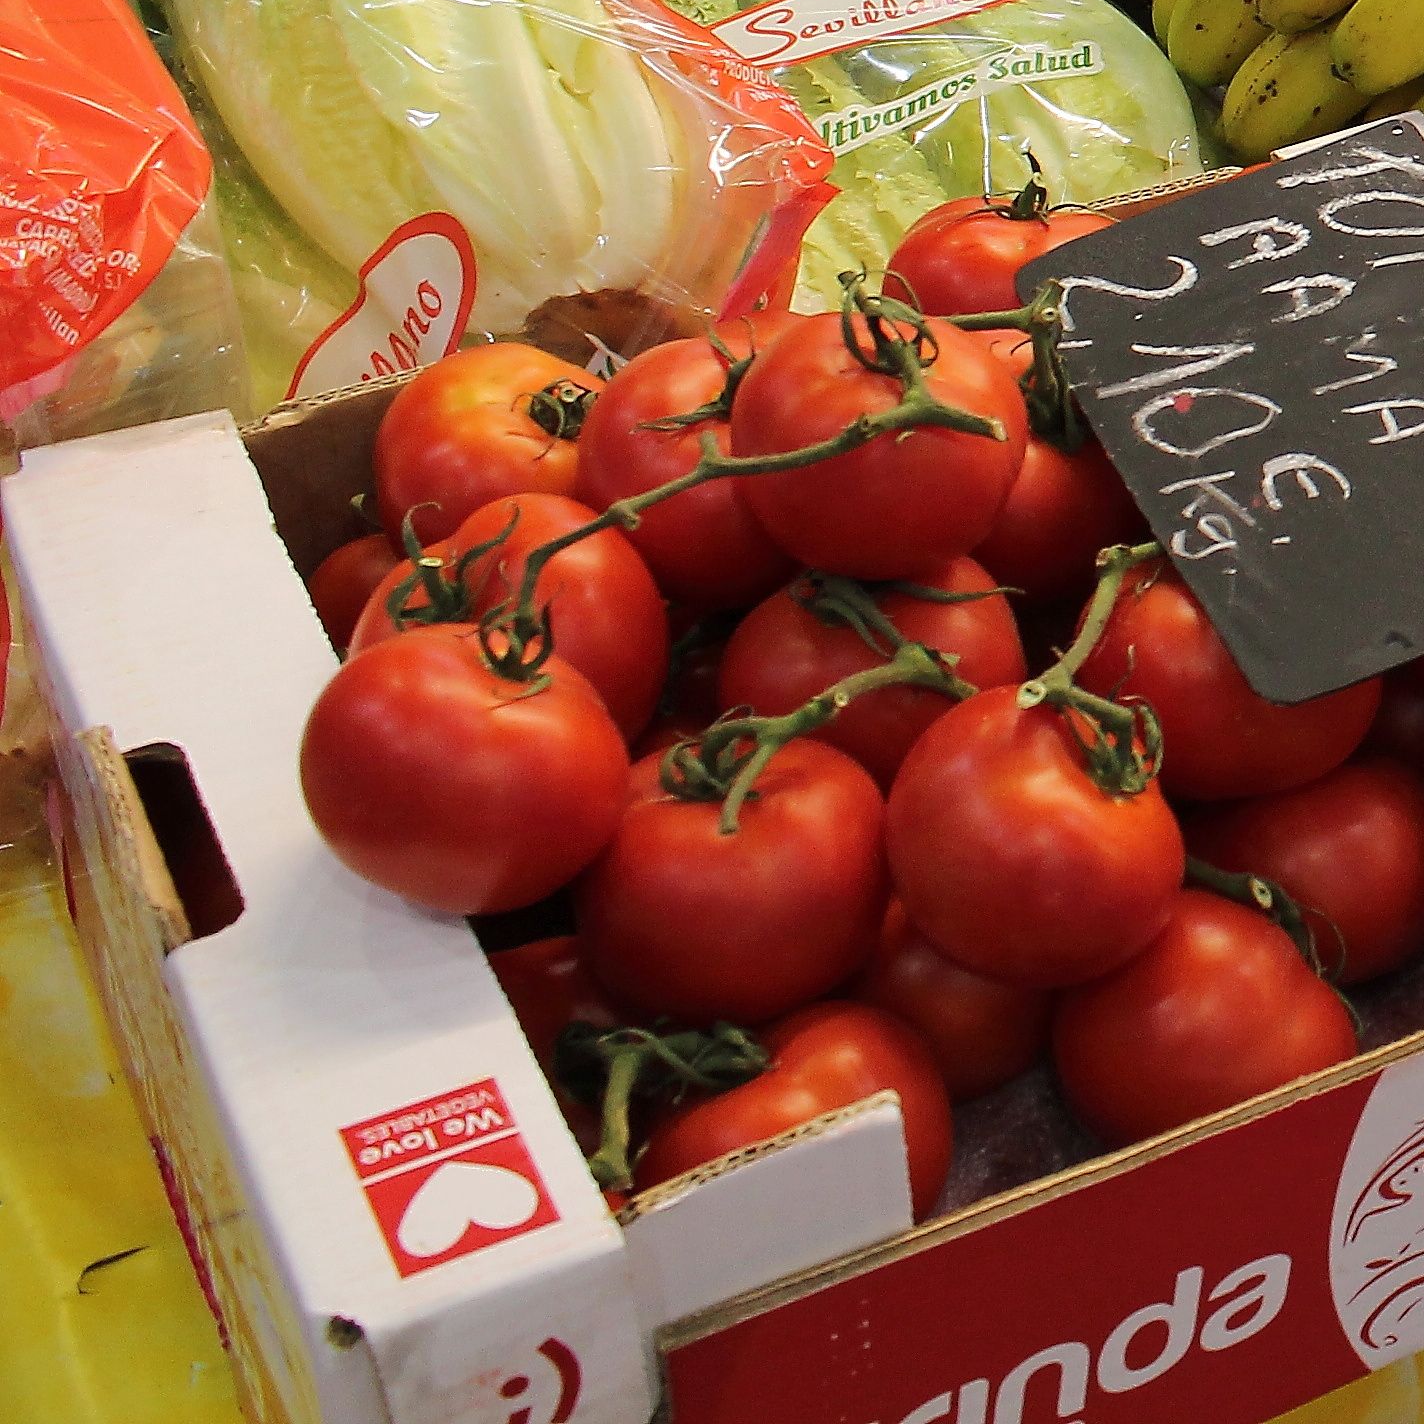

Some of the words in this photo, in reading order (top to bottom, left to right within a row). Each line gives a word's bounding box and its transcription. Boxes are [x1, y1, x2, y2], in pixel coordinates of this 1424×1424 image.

[987, 45, 1094, 80] Salud
[355, 1088, 498, 1147] VEGETABLES
[441, 1107, 505, 1137] We
[357, 1127, 440, 1166] love
